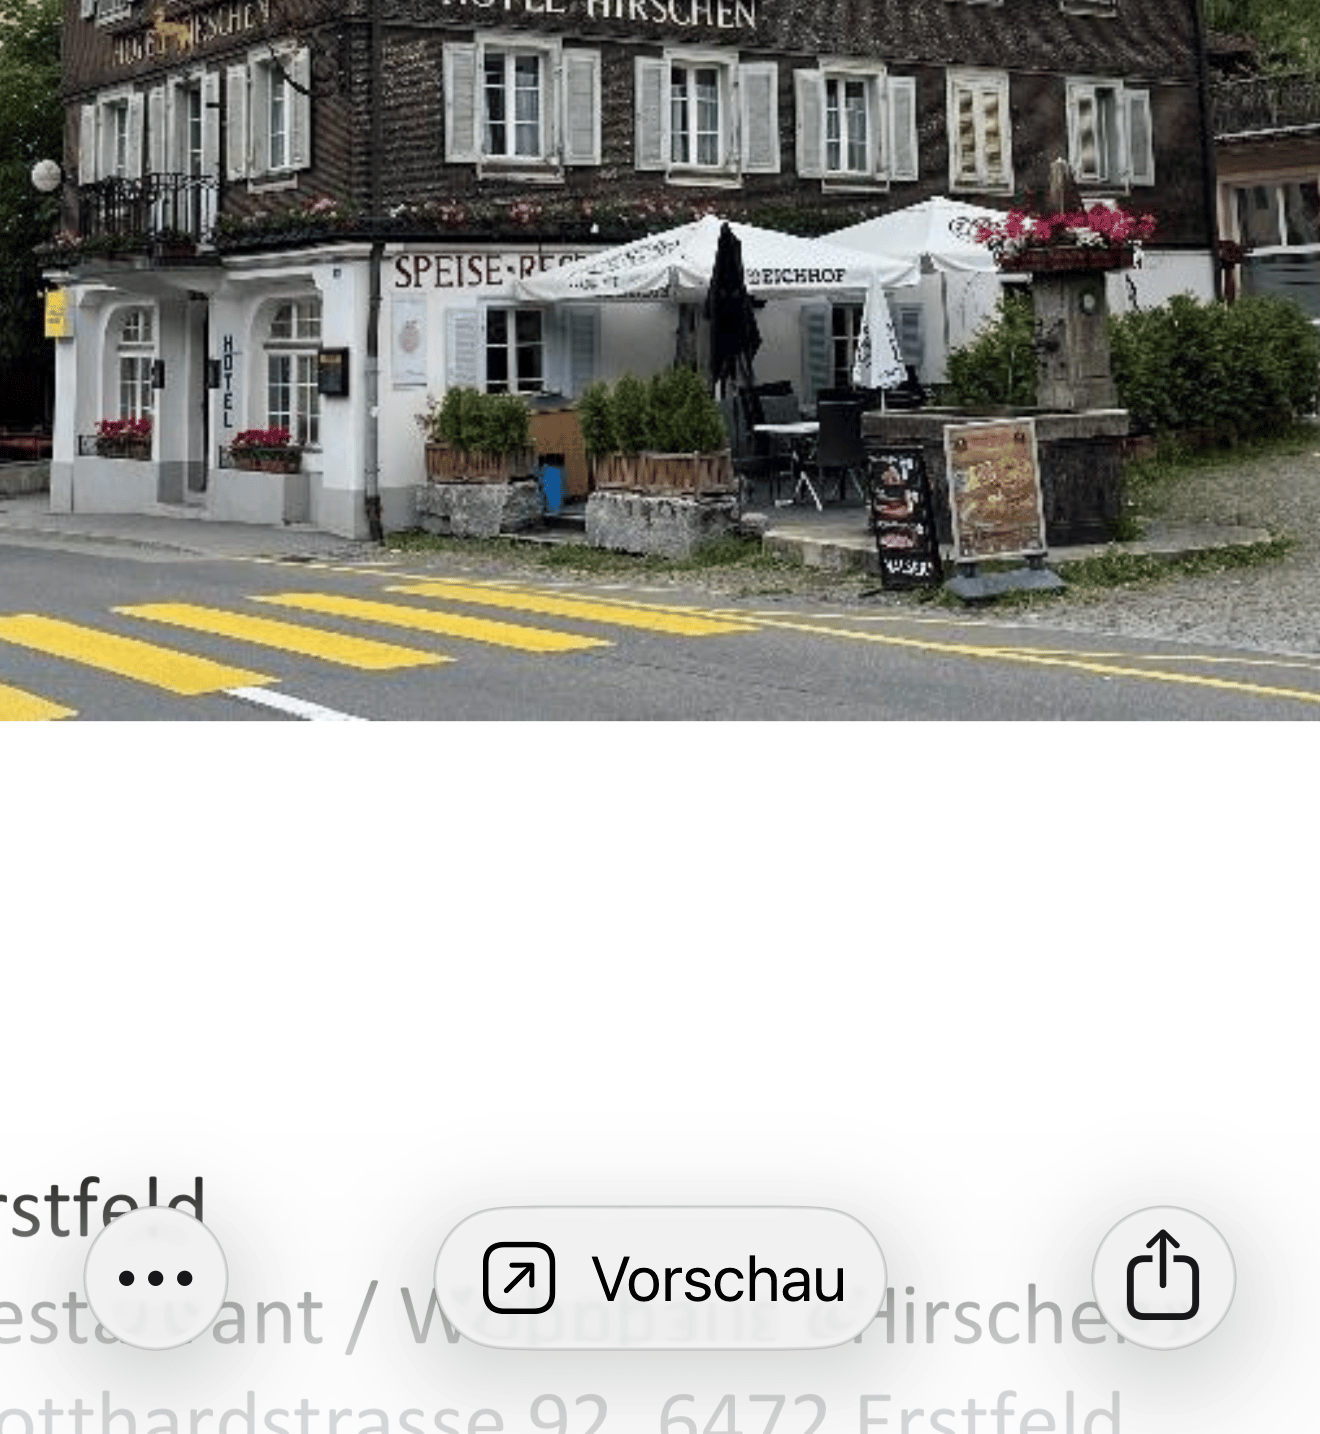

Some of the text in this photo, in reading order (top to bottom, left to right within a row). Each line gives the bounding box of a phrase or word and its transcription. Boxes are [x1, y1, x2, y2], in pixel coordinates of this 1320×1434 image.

[761, 268, 847, 285] EICHHOF
[223, 334, 233, 428] HOTEL
[591, 1254, 844, 1303] Vorschau
[660, 1393, 827, 1434] 6472
[859, 1389, 1121, 1434] Erstfeld
